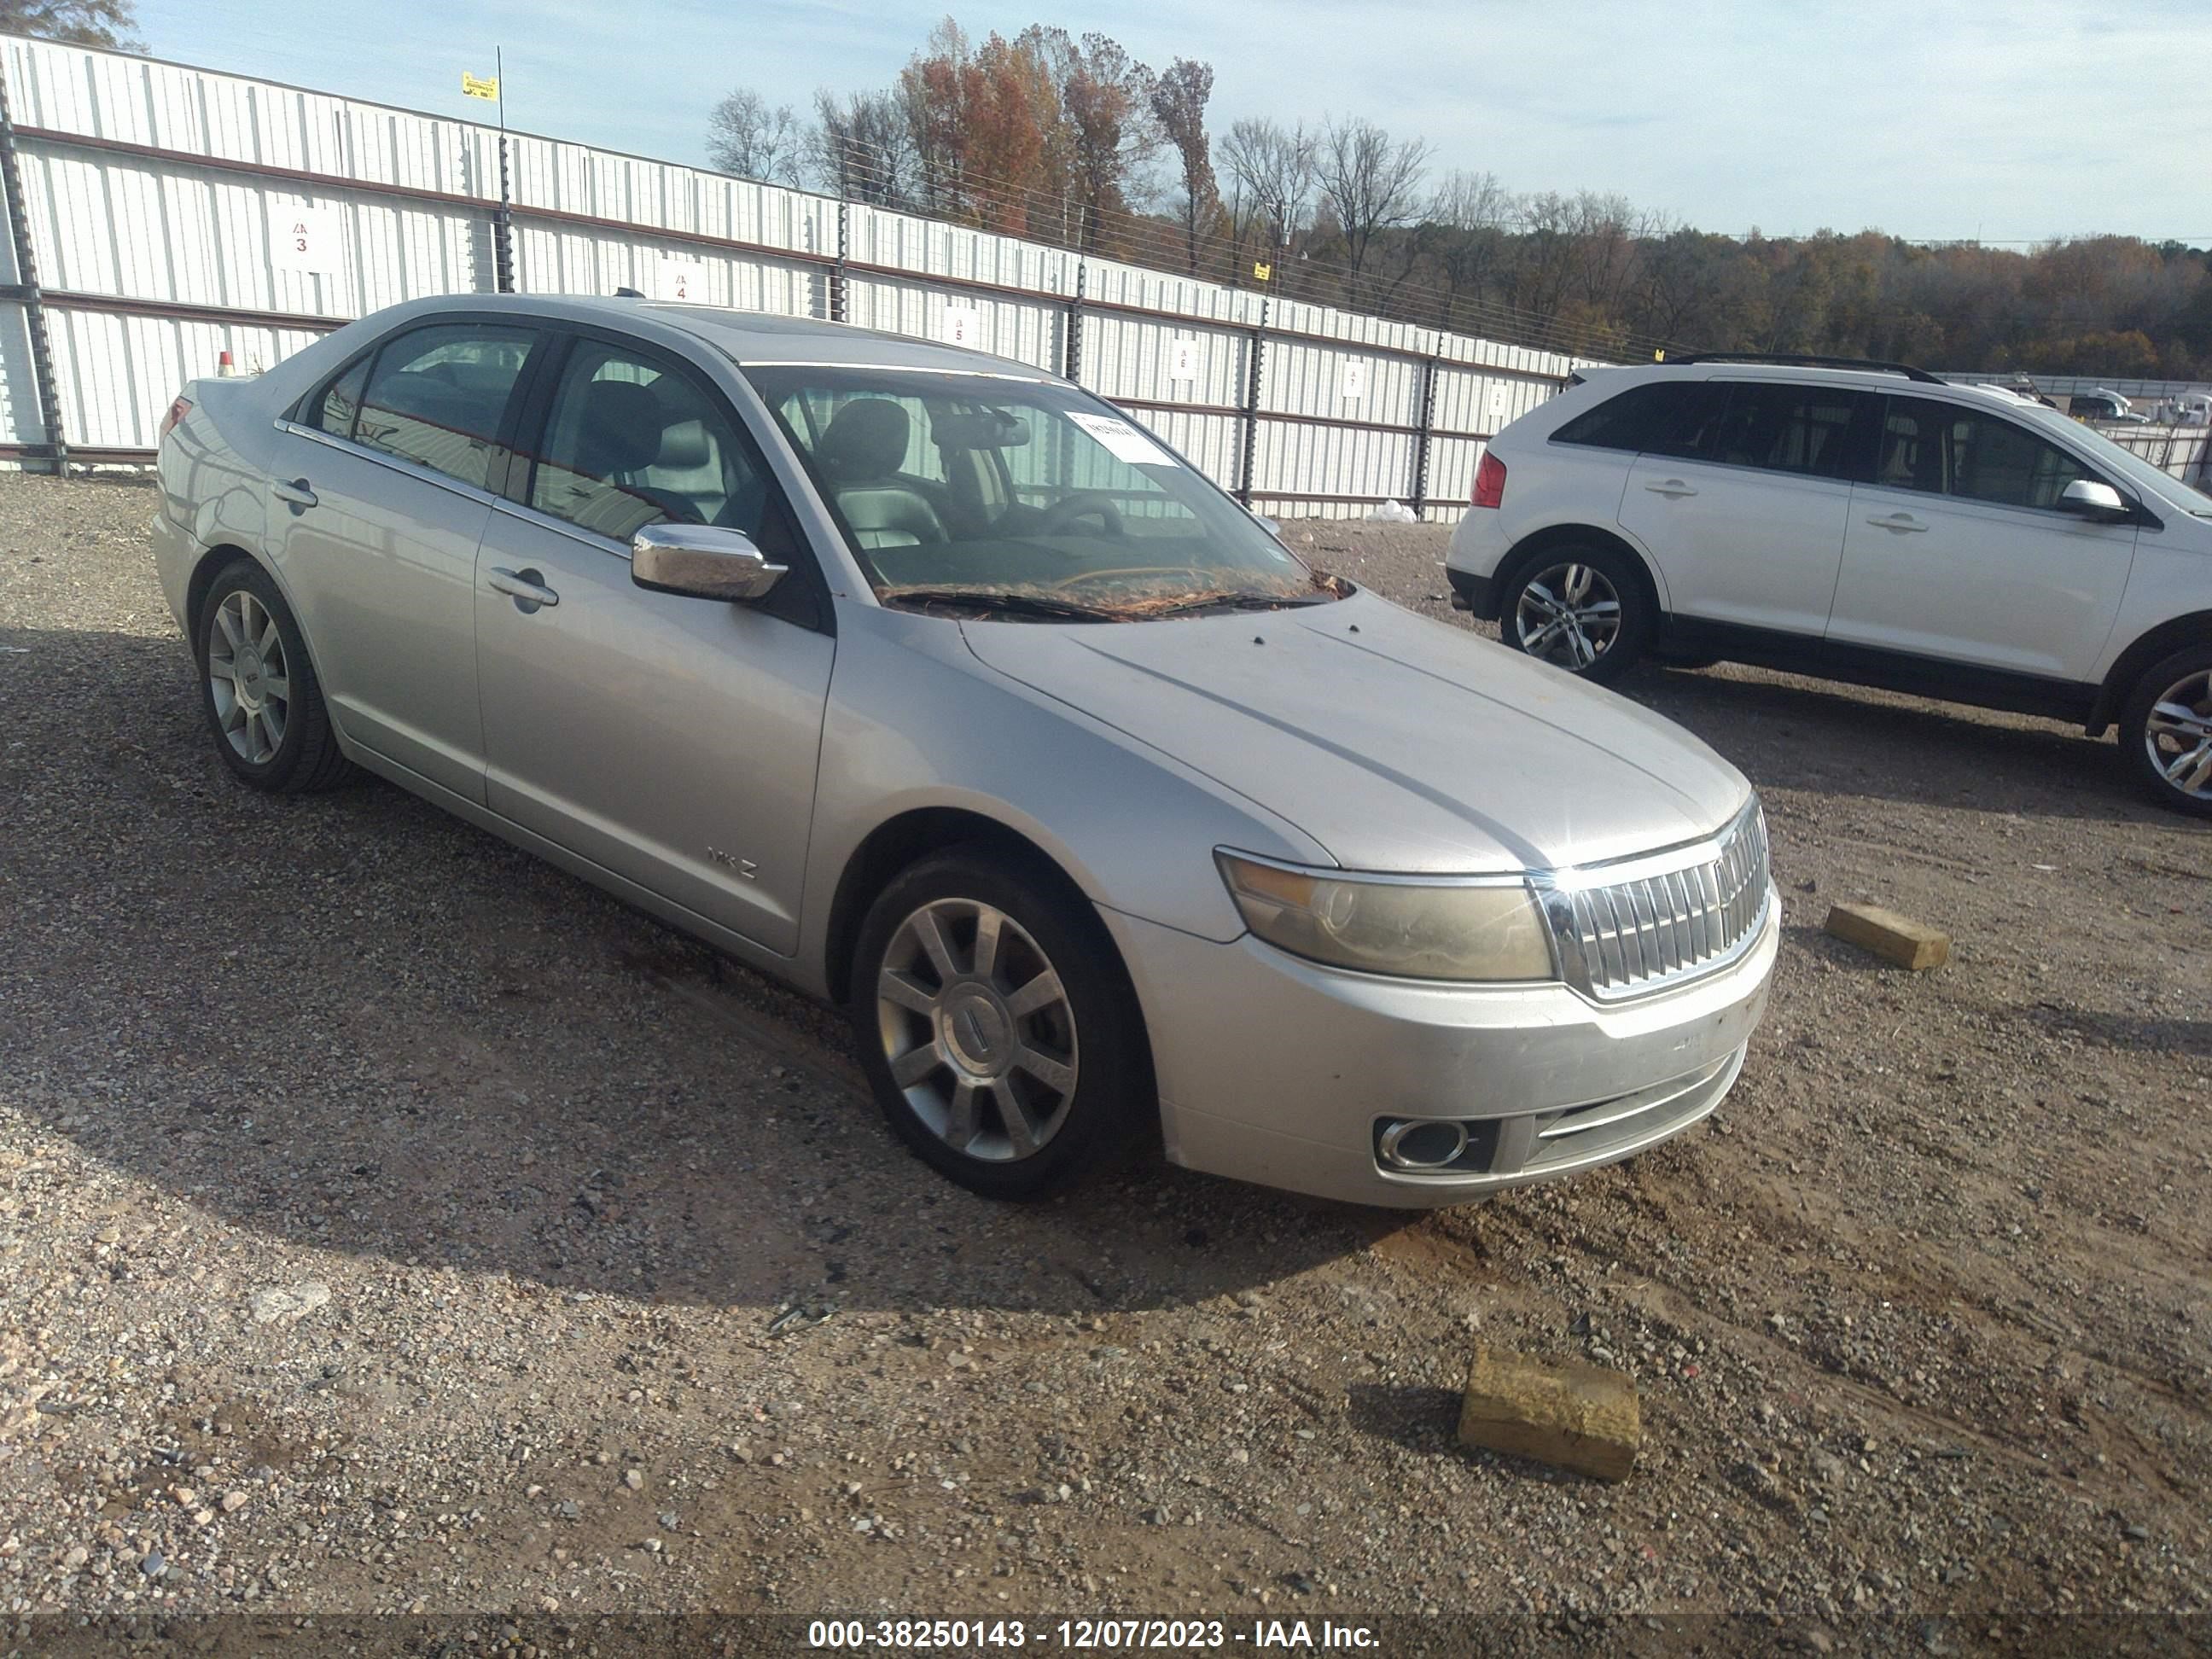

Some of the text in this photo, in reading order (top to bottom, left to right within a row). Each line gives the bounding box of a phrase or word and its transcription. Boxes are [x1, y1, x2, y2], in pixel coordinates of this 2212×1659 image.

[296, 238, 307, 252] 3
[677, 287, 687, 300] 4
[955, 329, 963, 341] 5
